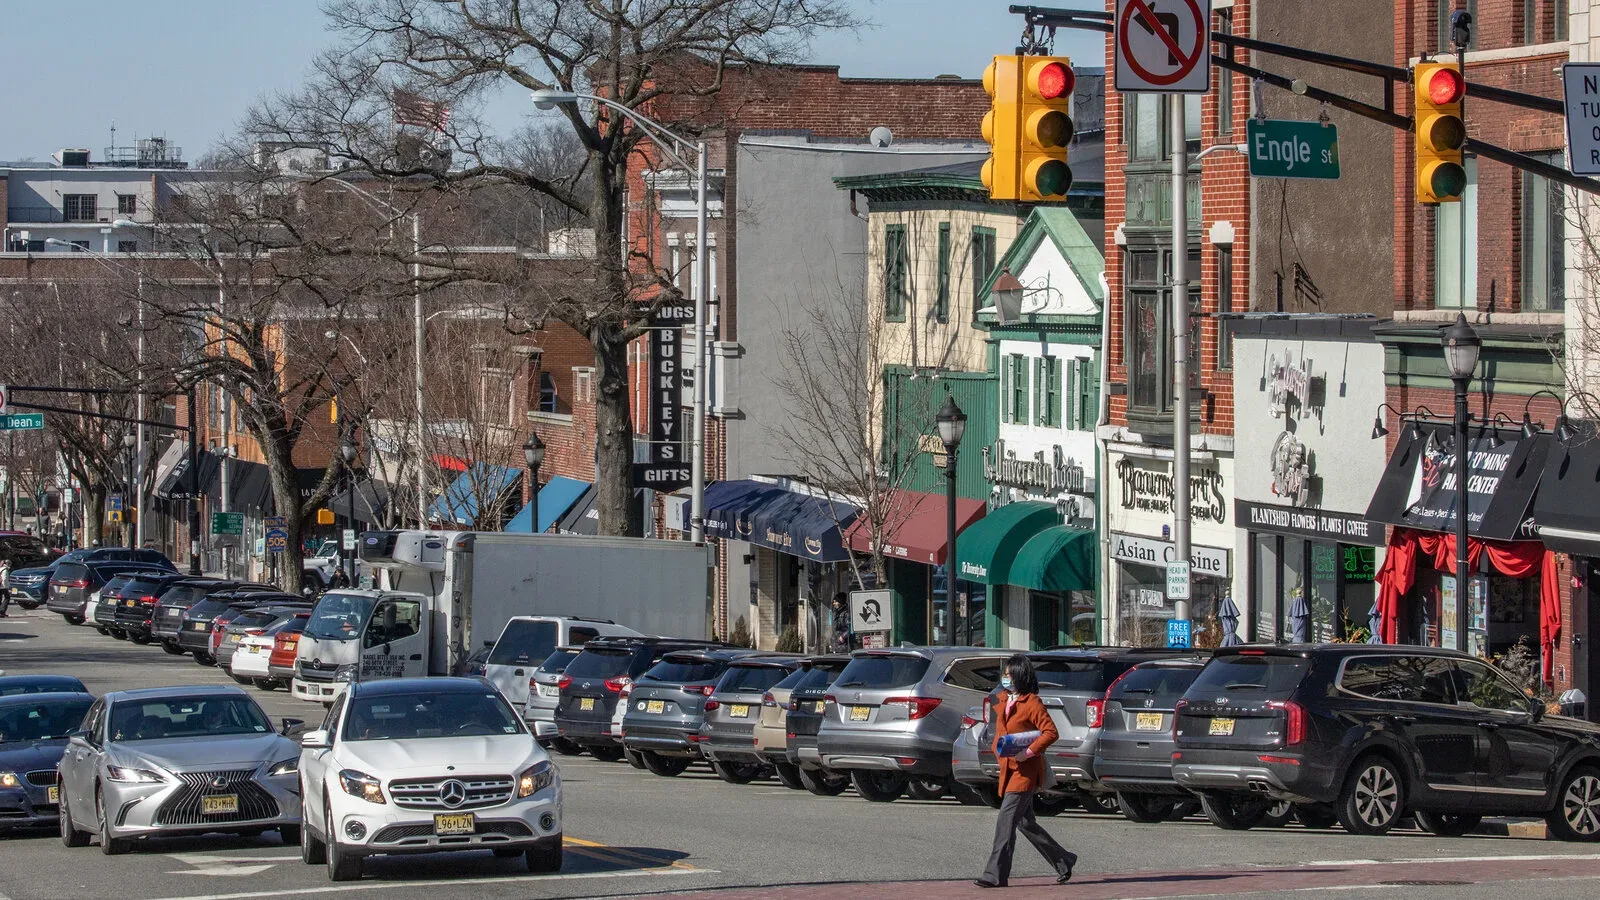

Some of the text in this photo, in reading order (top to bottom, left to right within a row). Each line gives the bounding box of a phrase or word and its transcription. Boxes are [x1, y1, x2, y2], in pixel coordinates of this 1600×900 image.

[1584, 75, 1598, 94] N
[1581, 102, 1600, 118] TU
[1592, 125, 1600, 141] O
[1255, 132, 1333, 170] Engle St
[7, 416, 33, 428] Dean
[644, 469, 690, 482] GIFTS
[1467, 475, 1498, 494] CENTER
[1251, 507, 1368, 536] PLANTSHED FLOWERS PLANTS COFFEE
[268, 537, 286, 547] 505
[1116, 539, 1220, 571] Asian Csine
[1168, 576, 1187, 584] PARKING
[1140, 589, 1163, 607] OPEN
[1171, 586, 1185, 594] ONLY
[1169, 622, 1188, 631] FREE
